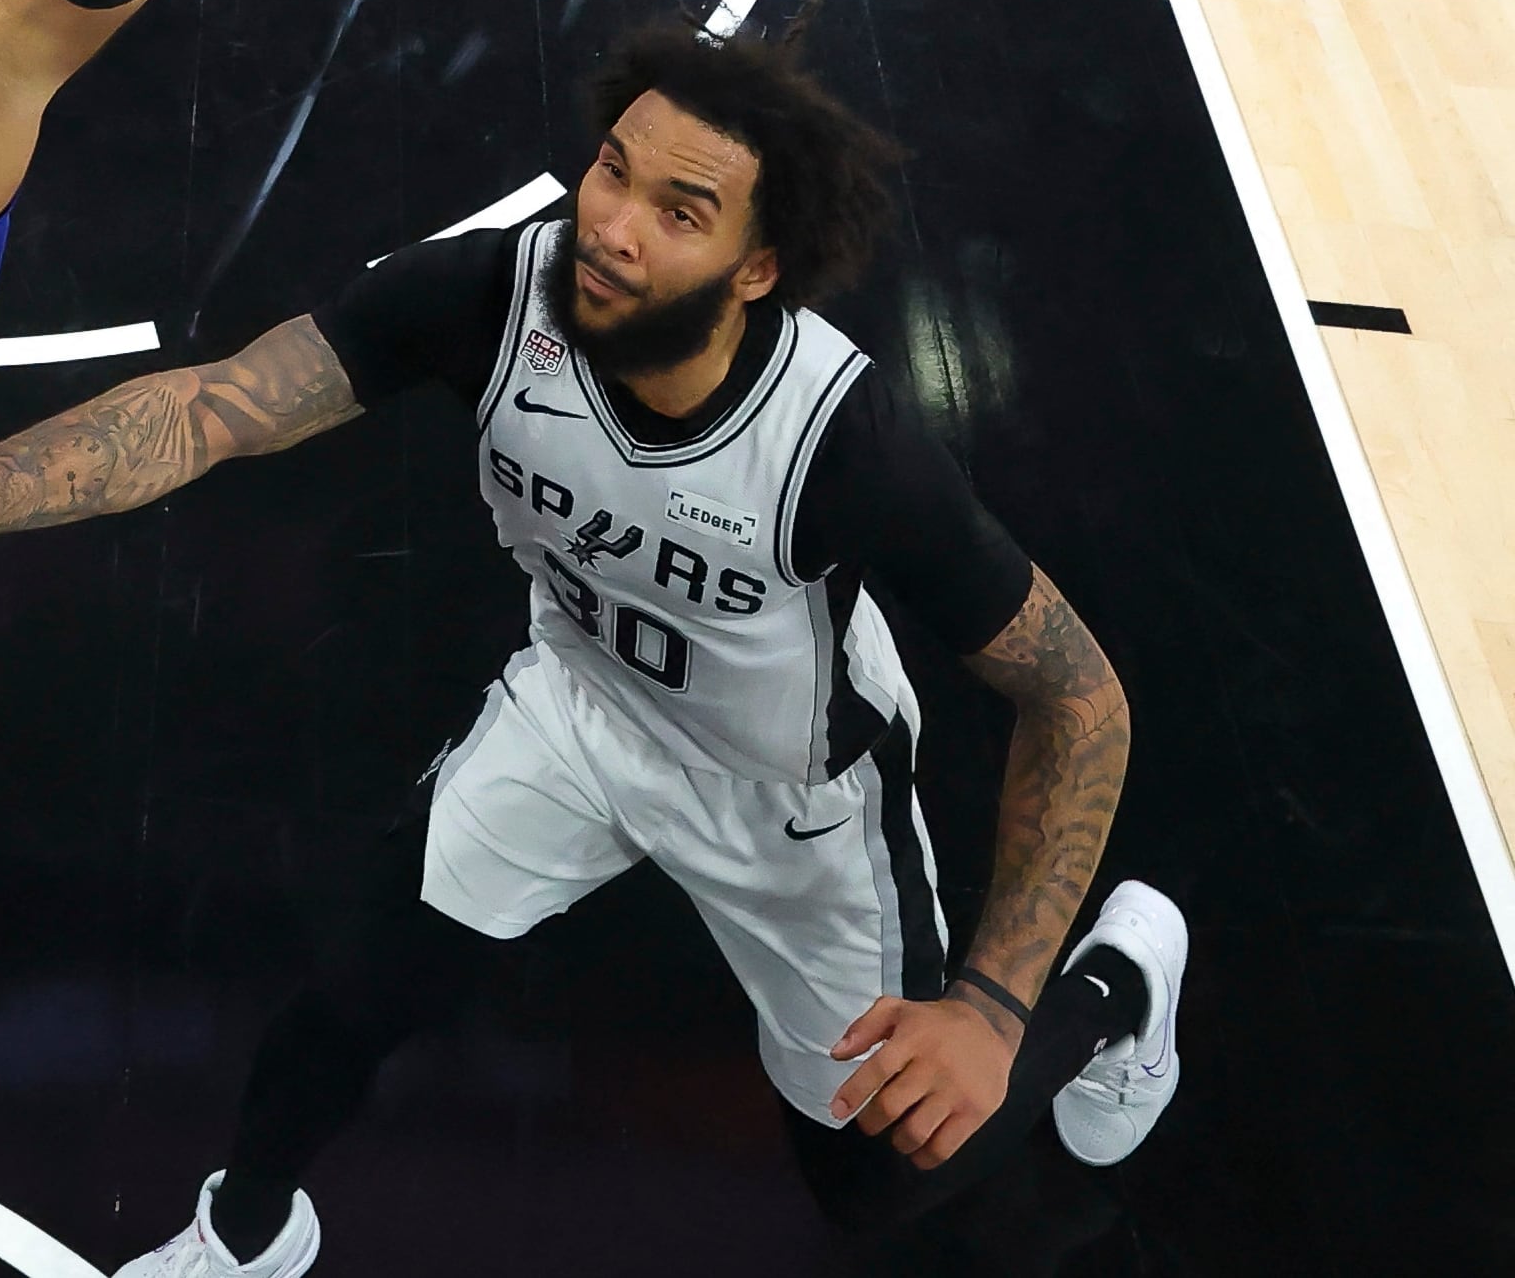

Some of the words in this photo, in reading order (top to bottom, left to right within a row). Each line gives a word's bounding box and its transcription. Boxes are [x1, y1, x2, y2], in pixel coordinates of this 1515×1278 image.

[521, 346, 558, 371] 250
[530, 332, 561, 356] USA
[489, 447, 768, 616] SPURS
[678, 503, 743, 535] LEDGER
[541, 546, 693, 694] 30
